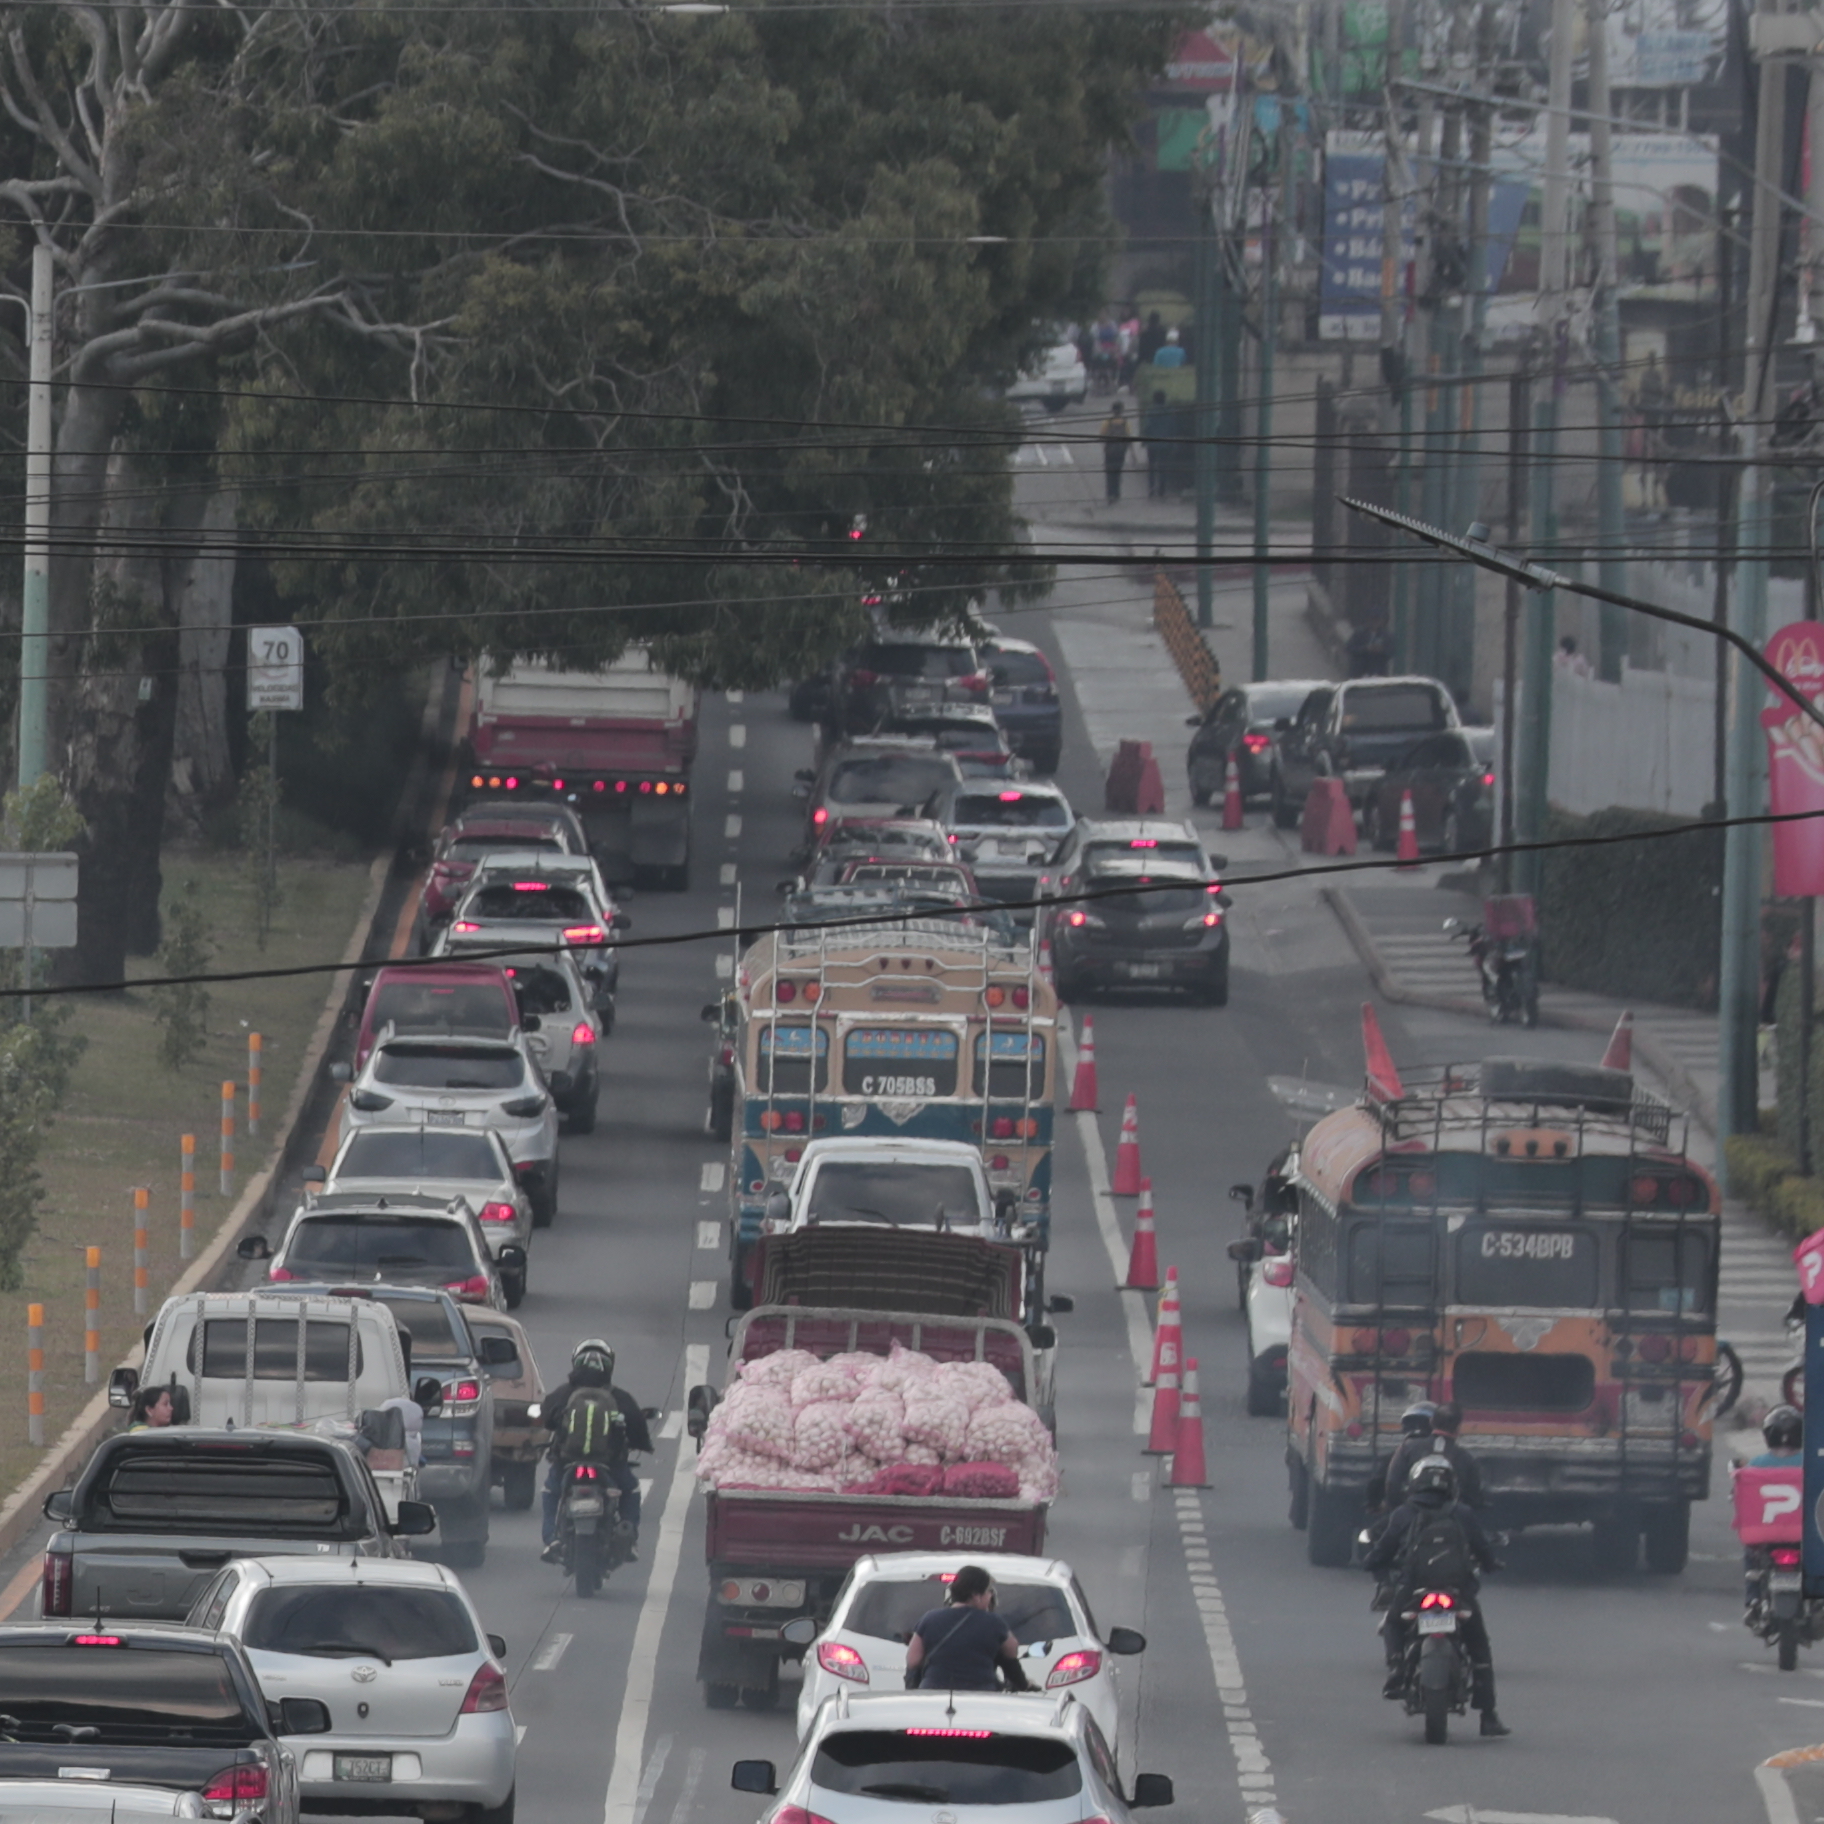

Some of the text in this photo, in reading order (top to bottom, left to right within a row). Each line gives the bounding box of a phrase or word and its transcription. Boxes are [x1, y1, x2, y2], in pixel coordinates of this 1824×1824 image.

[263, 641, 289, 660] 70
[861, 1076, 874, 1095] C
[1481, 1232, 1574, 1259] C-534BPB
[838, 1524, 914, 1543] JAC
